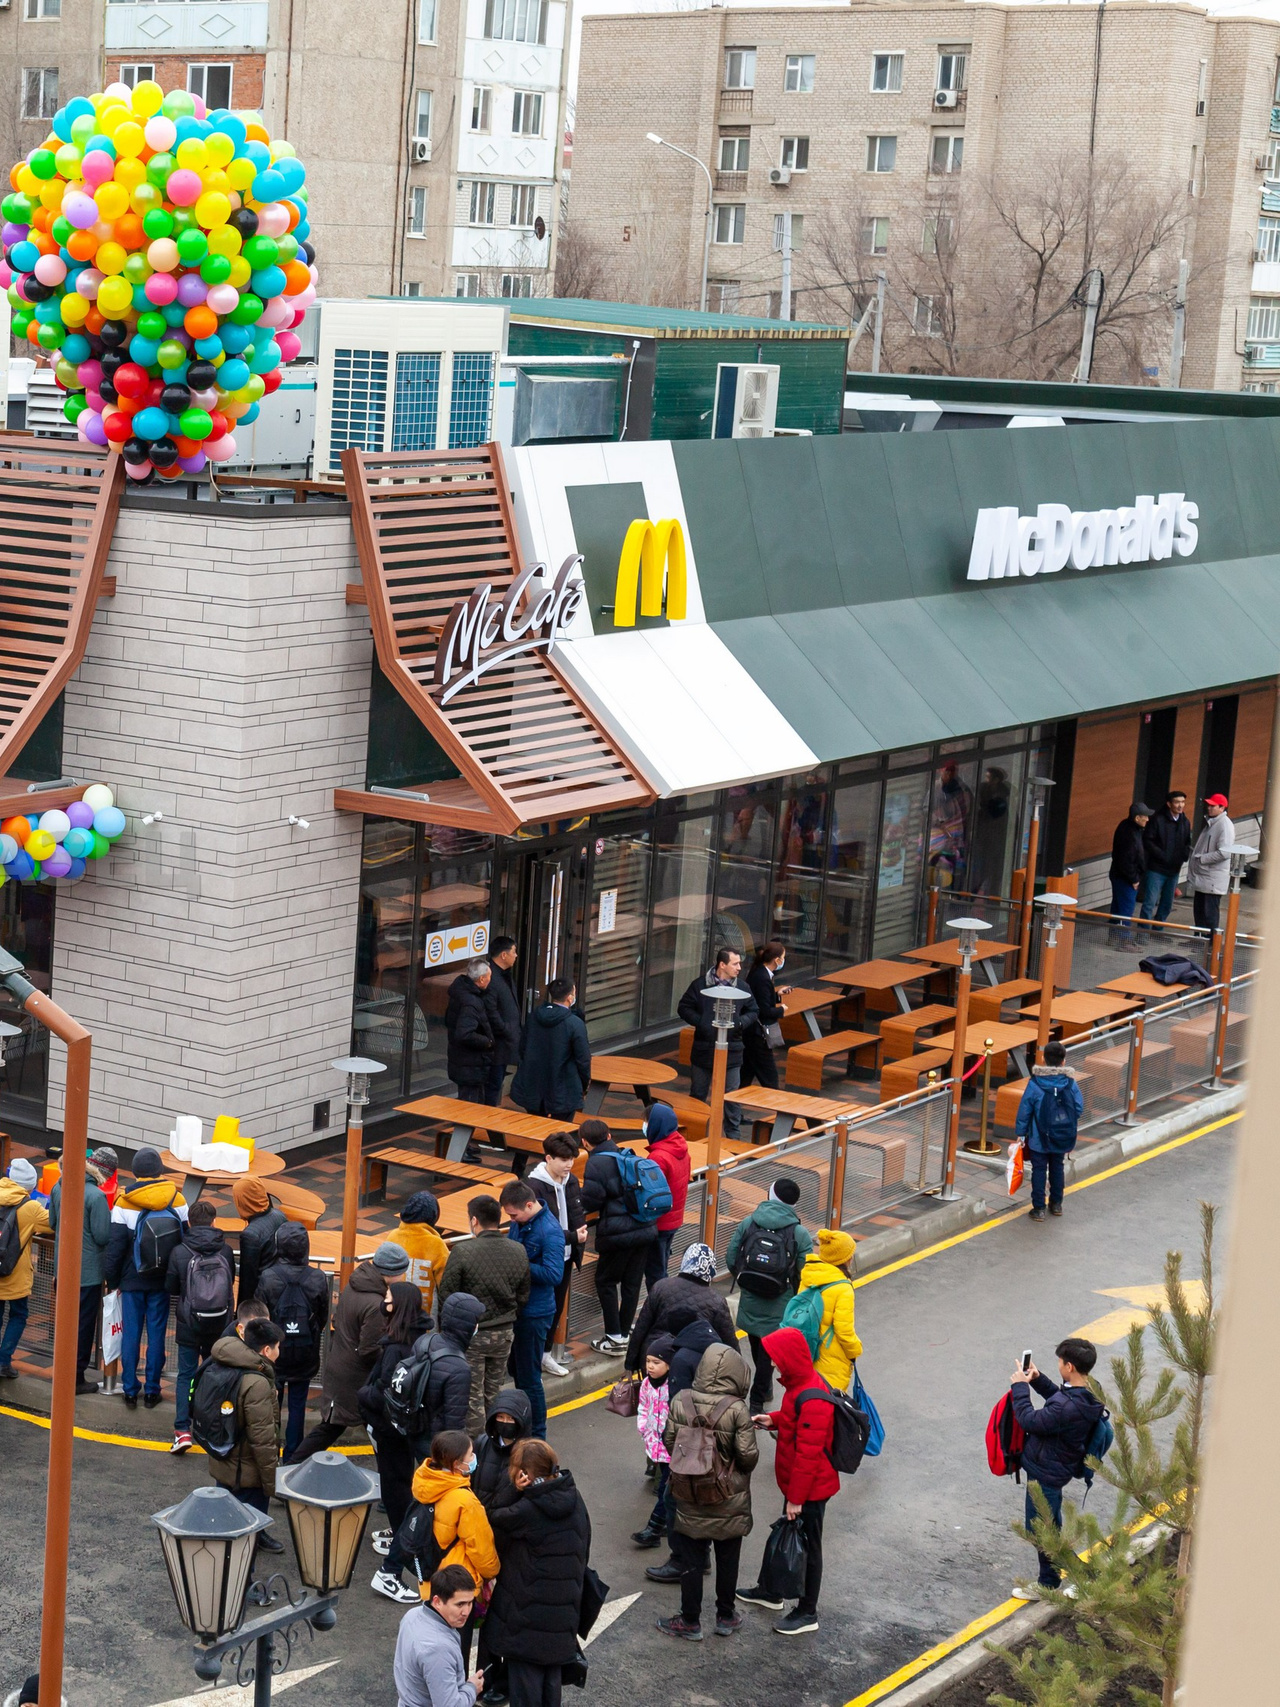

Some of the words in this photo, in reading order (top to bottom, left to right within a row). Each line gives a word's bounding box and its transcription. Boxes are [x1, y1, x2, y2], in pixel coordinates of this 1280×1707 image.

[623, 225, 631, 242] 5
[966, 492, 1200, 581] McDonald's
[433, 553, 586, 705] McCafé
